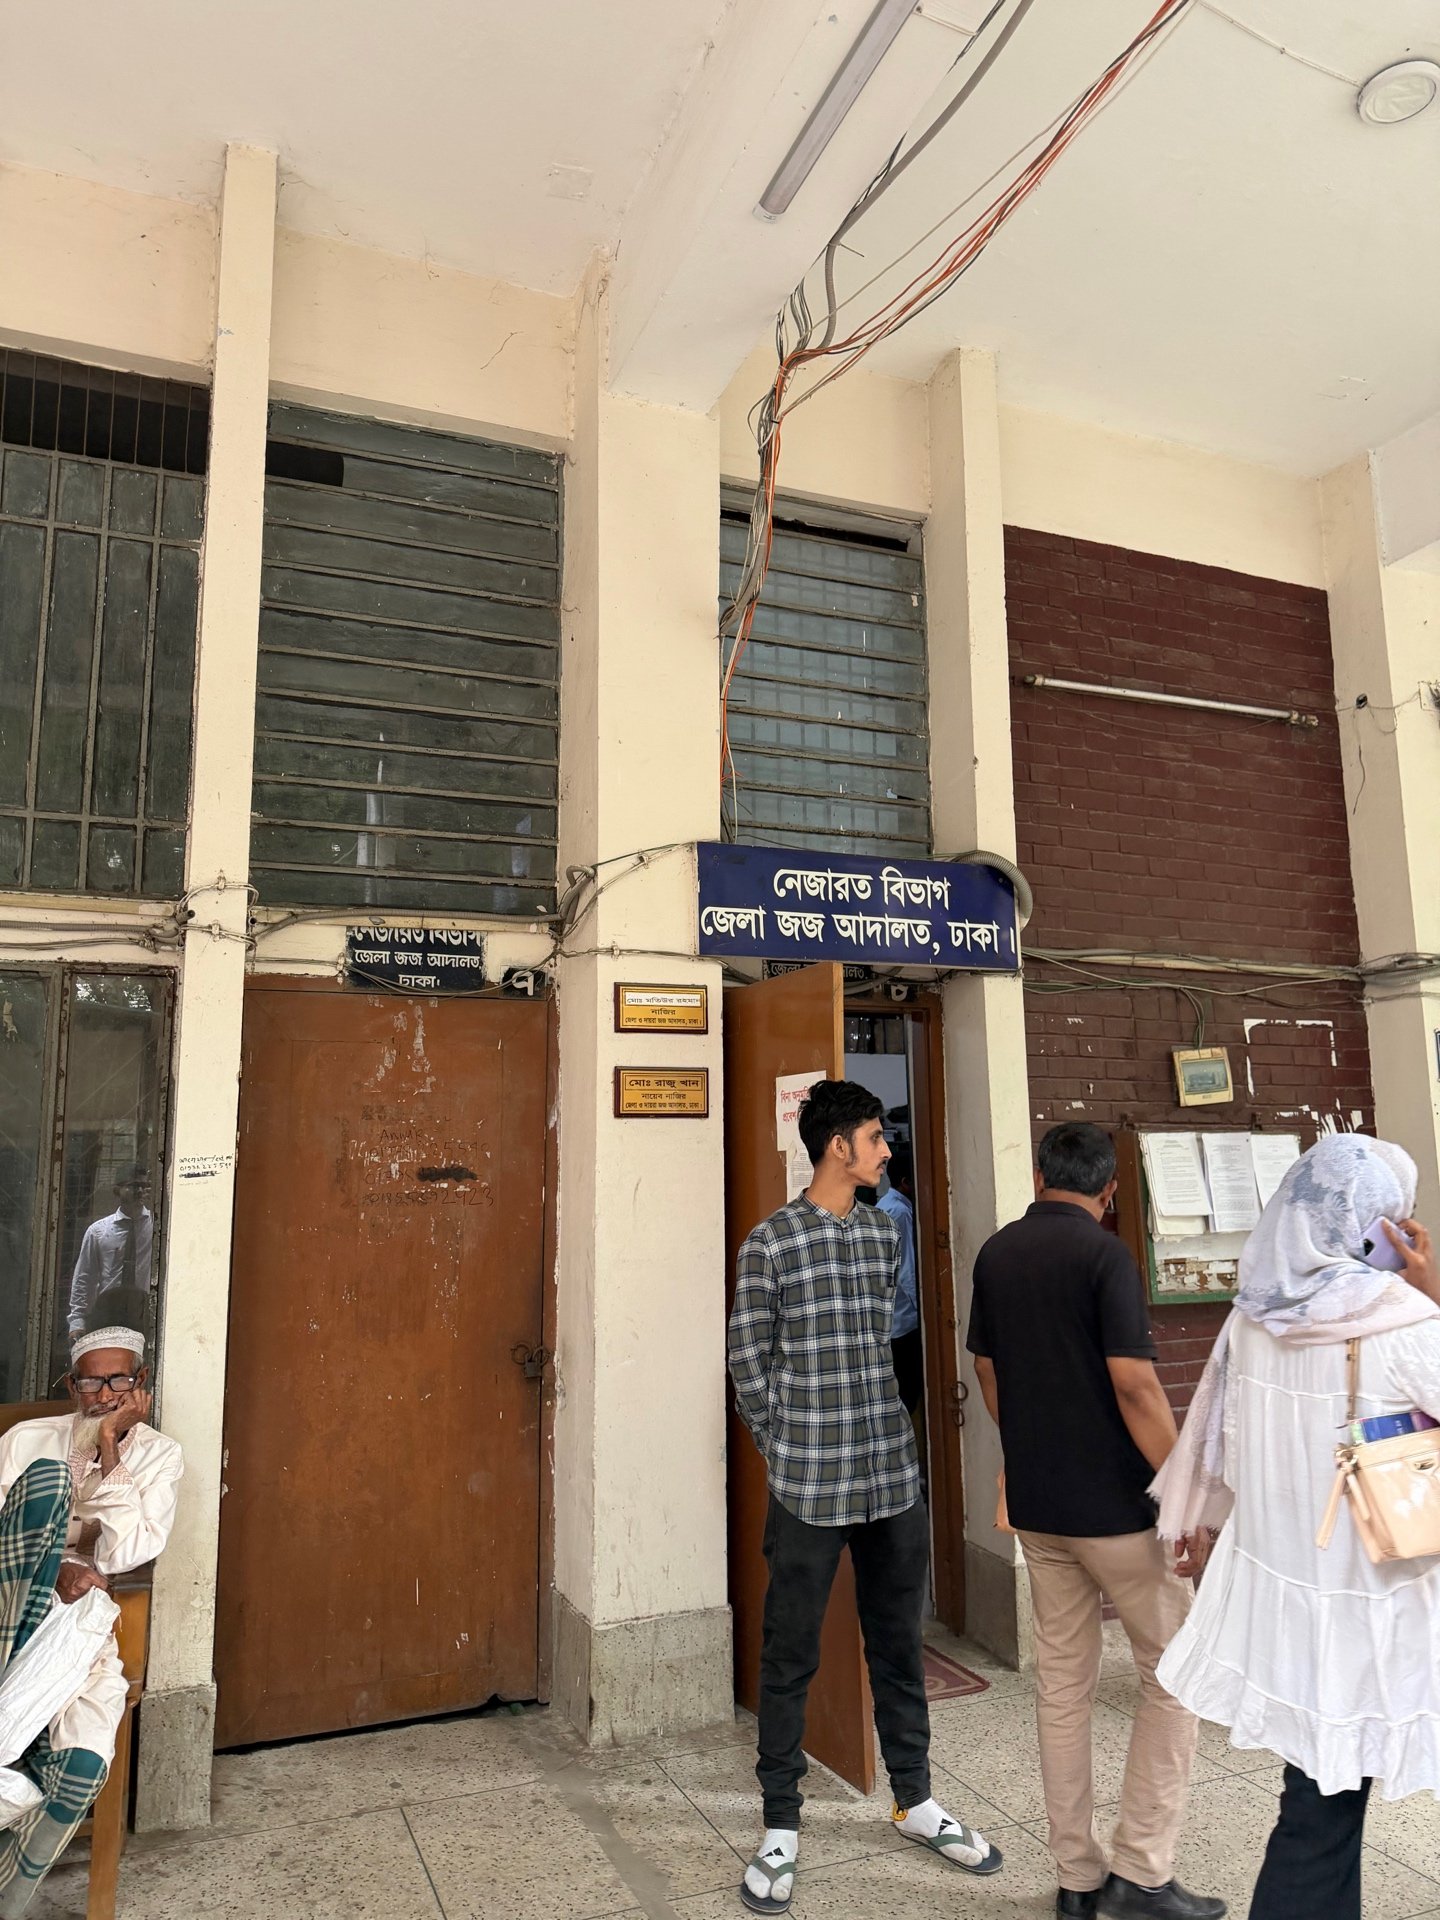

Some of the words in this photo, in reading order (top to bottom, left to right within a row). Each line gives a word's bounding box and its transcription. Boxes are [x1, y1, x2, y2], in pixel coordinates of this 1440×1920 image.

[773, 867, 873, 902] নেজারত
[879, 865, 951, 911] বিভাগ
[700, 905, 766, 941] জেলা
[774, 910, 825, 943] জজ
[831, 911, 940, 956] আদালত,
[354, 949, 390, 965] জেলা
[394, 951, 423, 967] জজ
[427, 953, 482, 970] আদালত,
[629, 1079, 651, 1087] মোঃ
